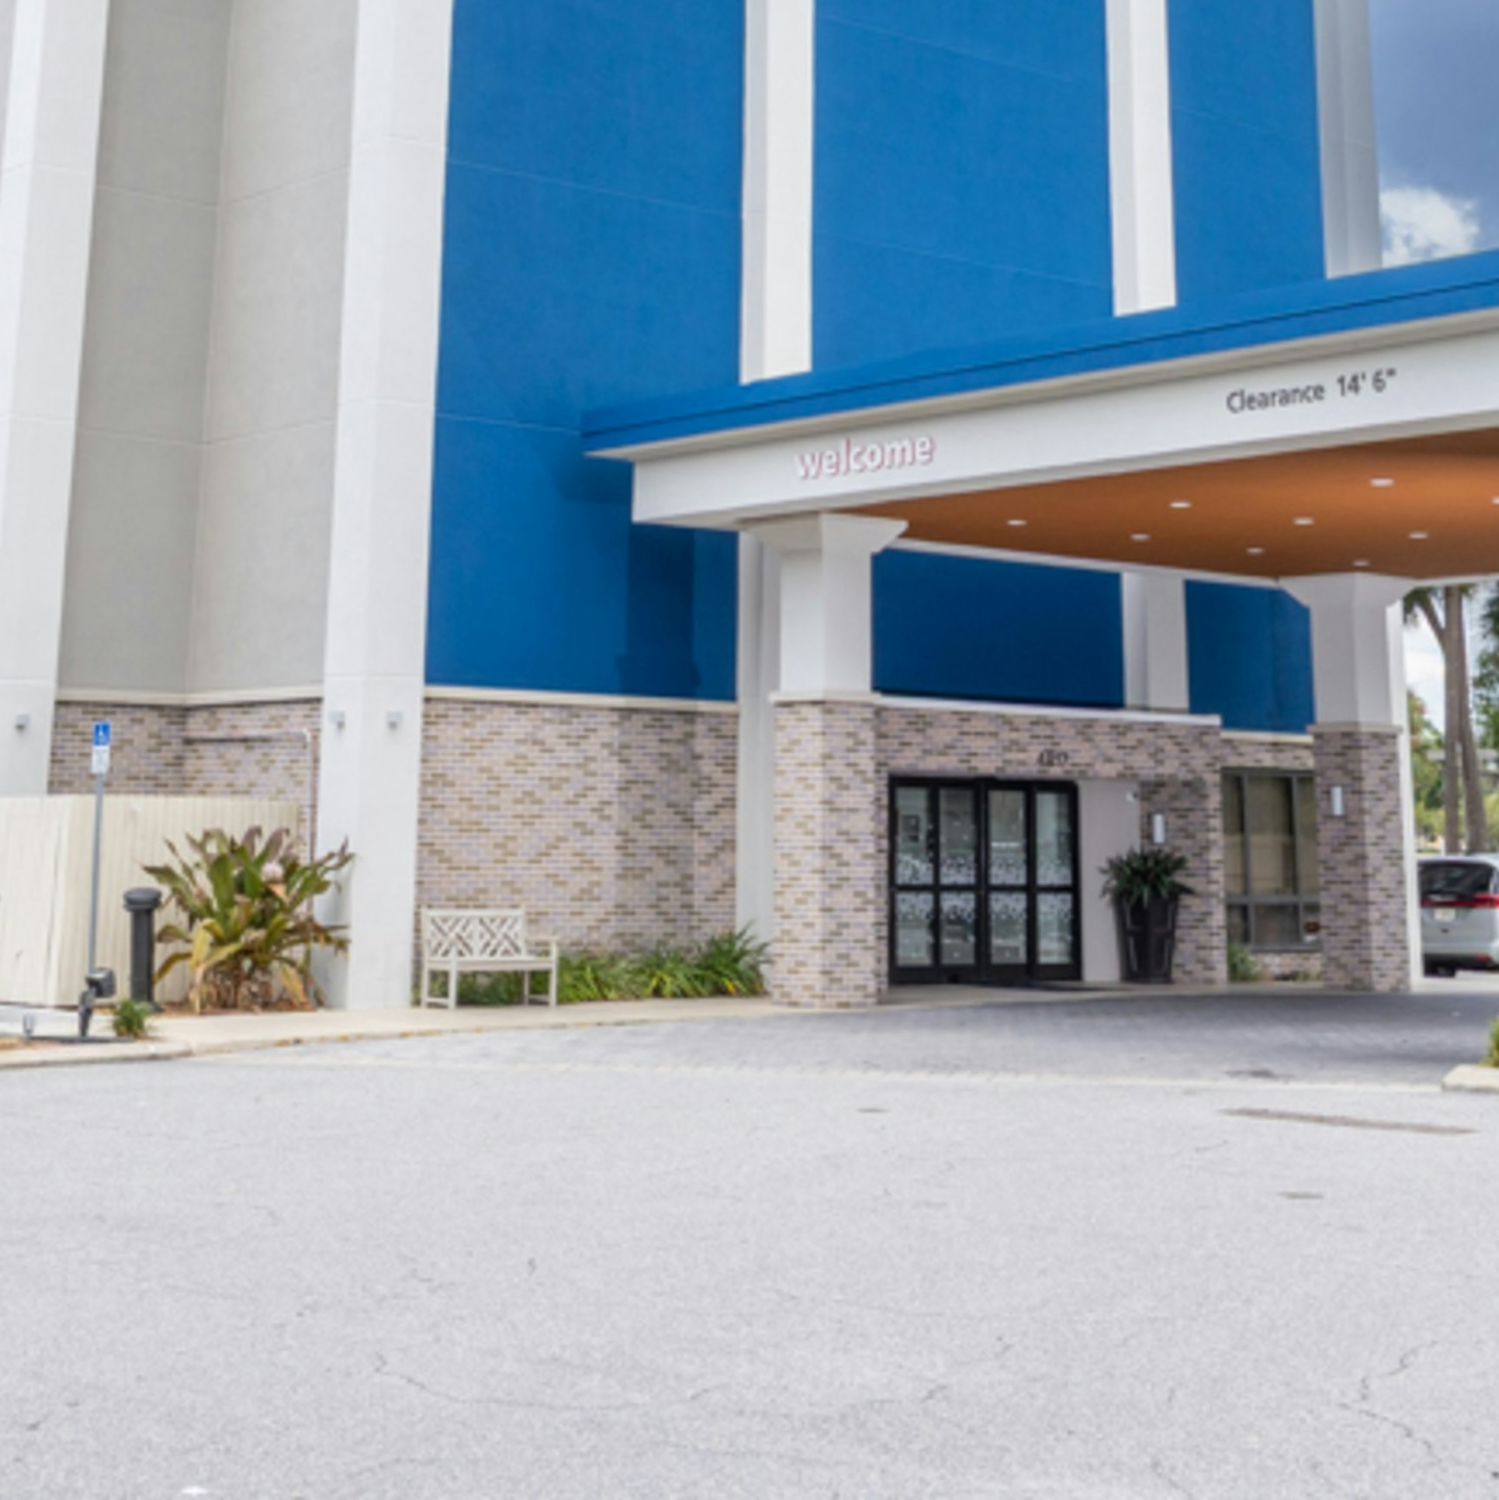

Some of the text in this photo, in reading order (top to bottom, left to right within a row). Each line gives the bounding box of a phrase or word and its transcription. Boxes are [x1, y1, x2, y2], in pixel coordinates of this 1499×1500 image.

[1226, 385, 1325, 414] Clearance
[1337, 372, 1366, 397] 14'
[795, 435, 936, 479] welcome
